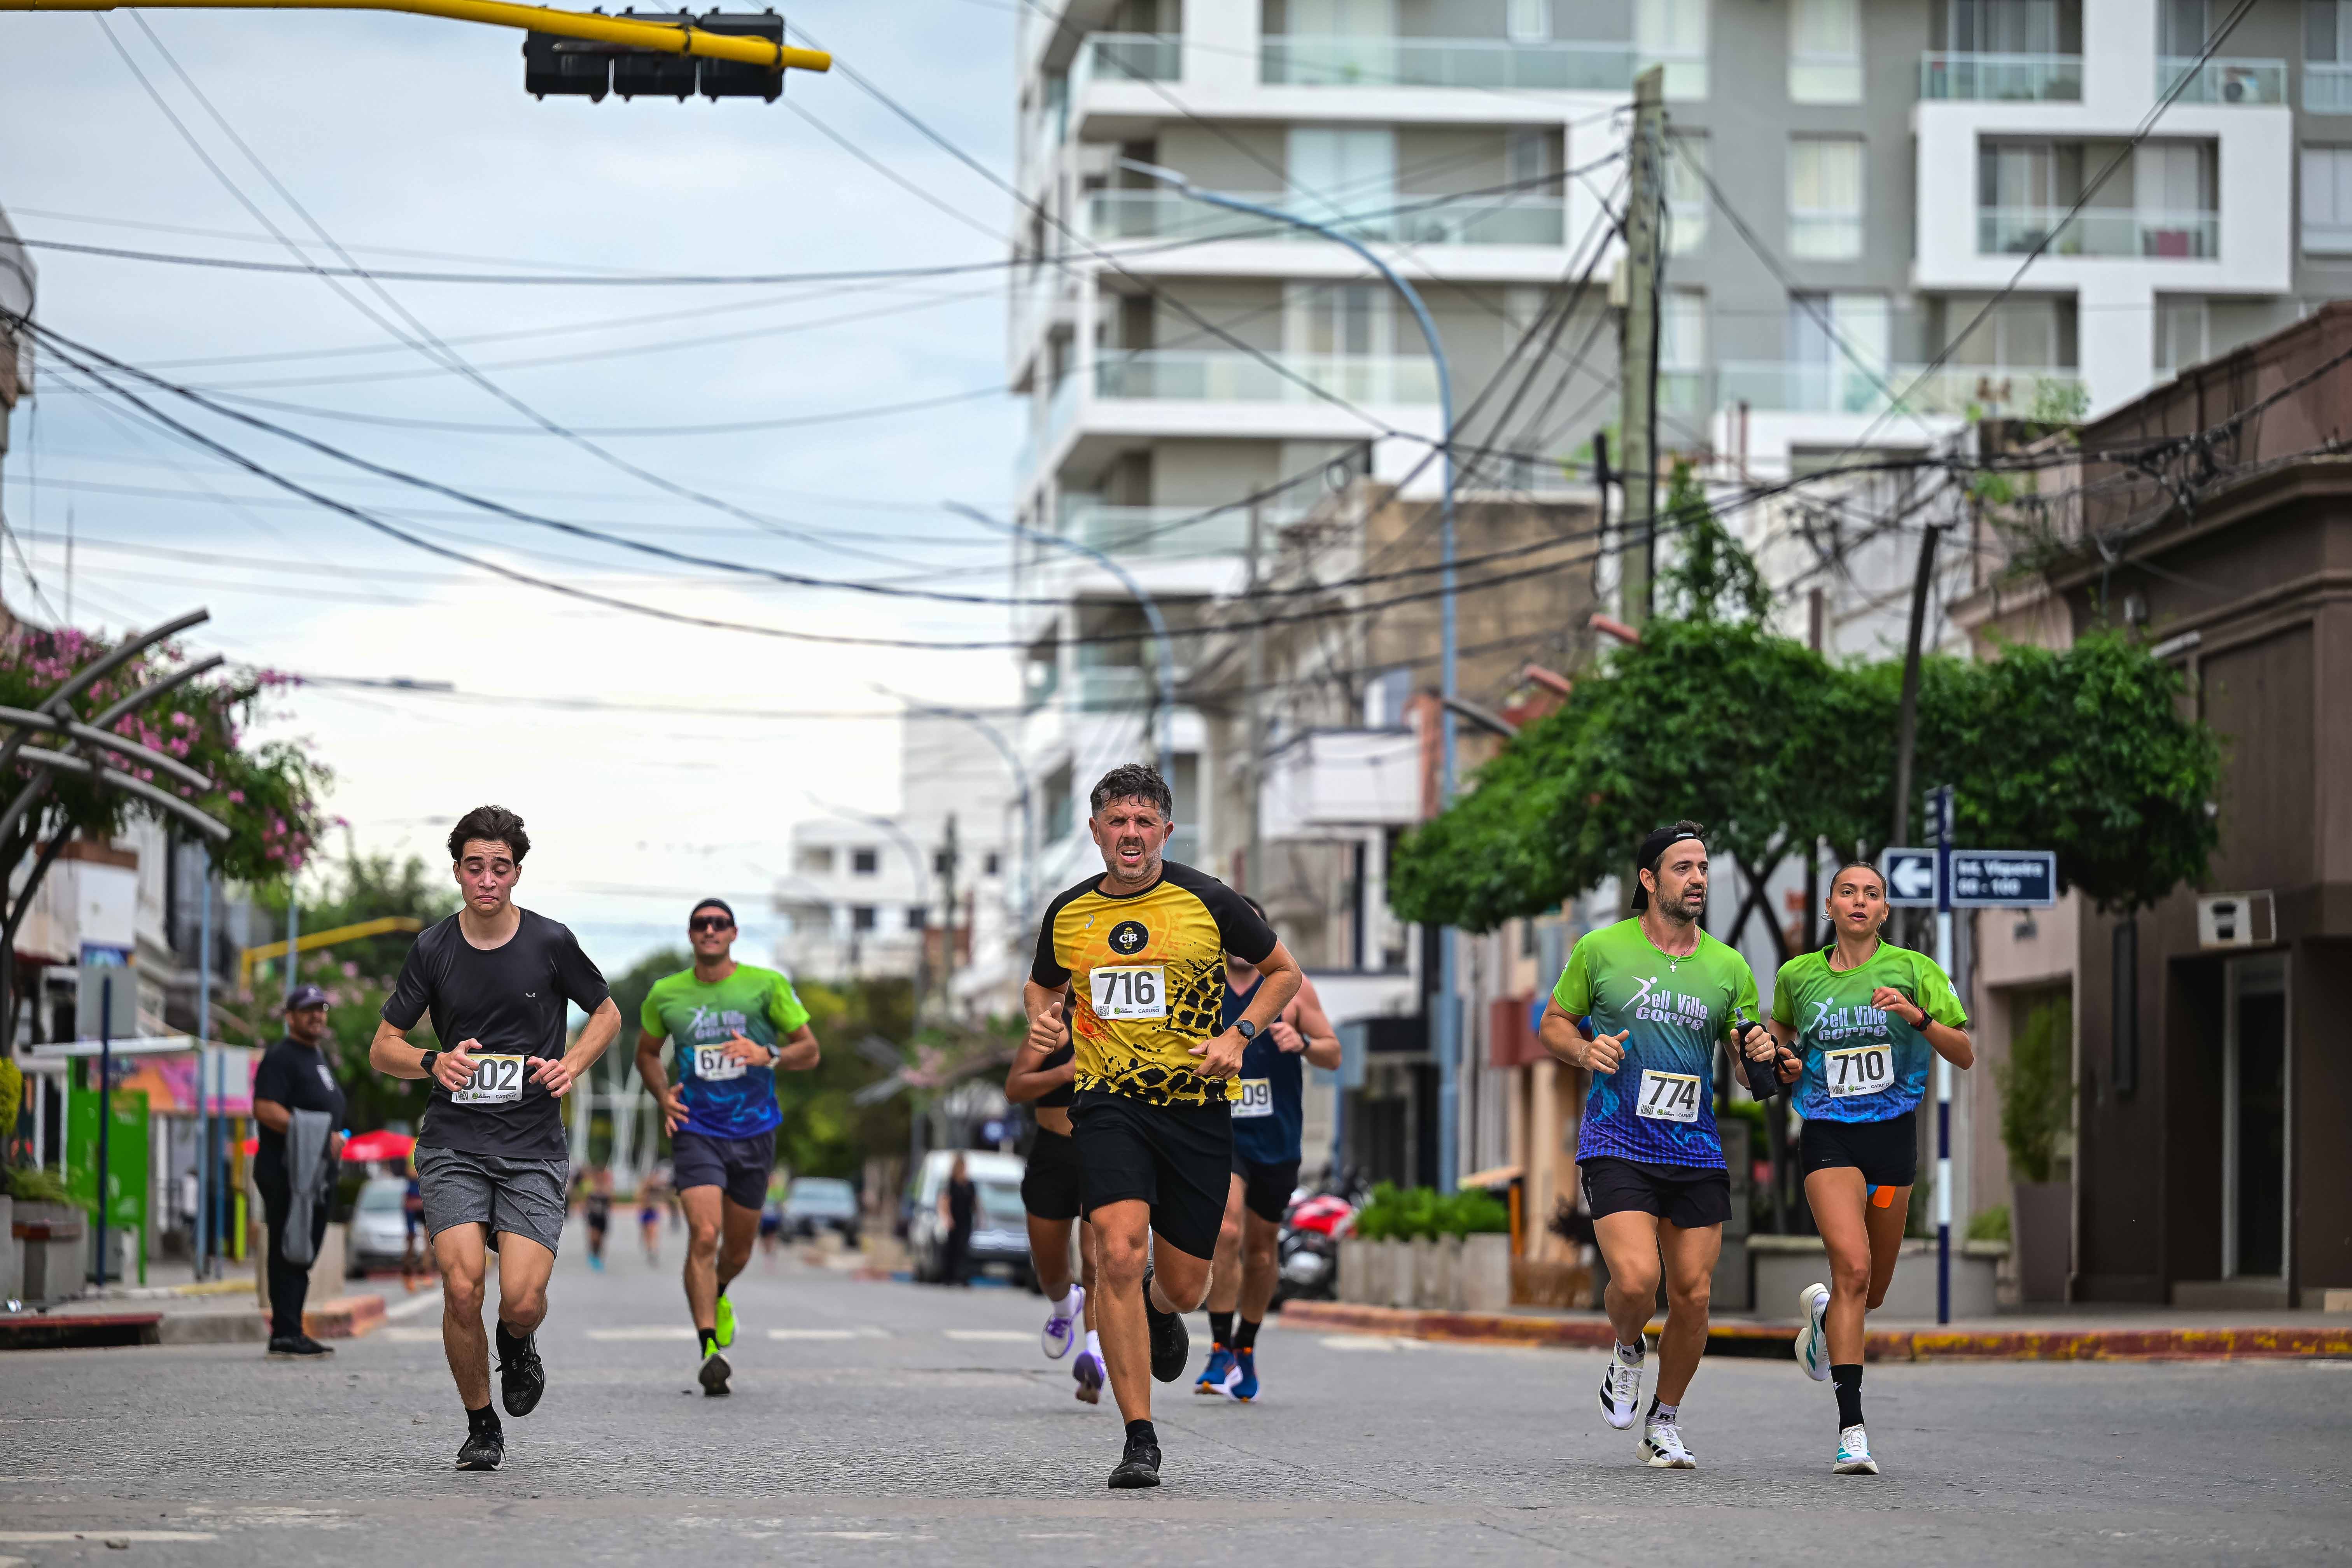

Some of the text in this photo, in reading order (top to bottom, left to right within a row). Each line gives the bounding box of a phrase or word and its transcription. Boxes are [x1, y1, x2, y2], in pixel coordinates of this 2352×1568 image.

[1119, 933, 1138, 943] CB
[1098, 971, 1155, 1004] 716
[1677, 992, 1708, 1019] Ville
[1853, 1005, 1887, 1025] Ville
[1636, 1007, 1704, 1031] corre
[1818, 1025, 1887, 1041] corre
[1832, 1050, 1885, 1085] 710
[1231, 1084, 1267, 1106] 09
[1648, 1075, 1696, 1110] 774
